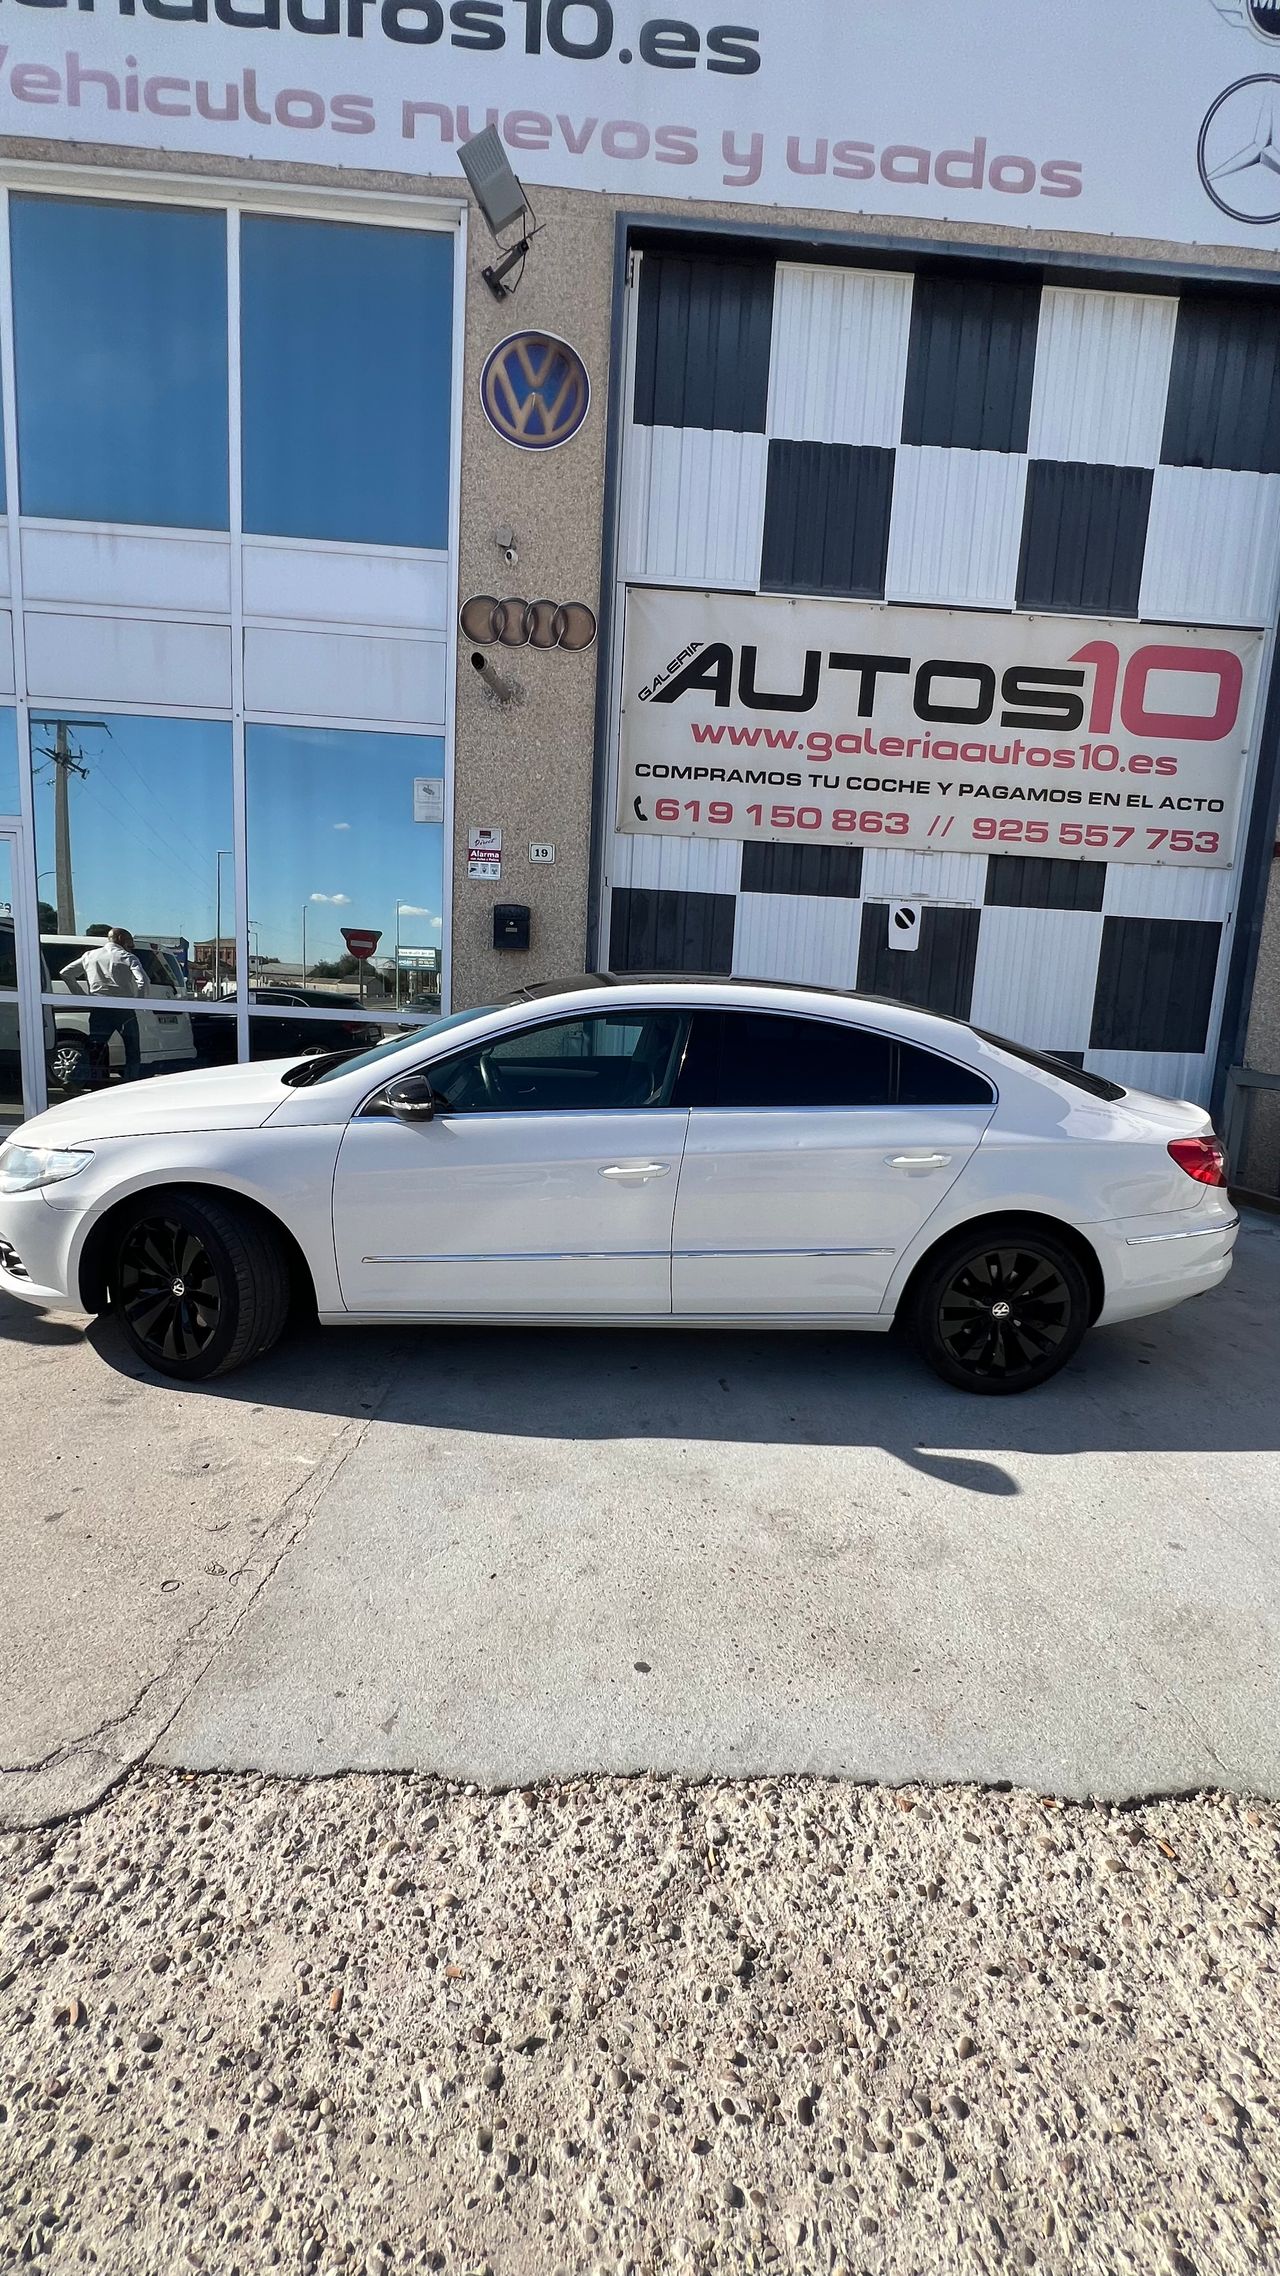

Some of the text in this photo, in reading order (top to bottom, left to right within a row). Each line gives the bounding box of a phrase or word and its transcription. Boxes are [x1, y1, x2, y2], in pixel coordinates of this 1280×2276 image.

[0, 46, 1083, 199] ehiculos nuevos y usados
[637, 642, 705, 702] GALERIA
[650, 640, 1243, 741] AUTOS10
[691, 723, 1178, 776] www.galeriaautos10.es
[635, 763, 1225, 813] COMPRAMOS TU COCHE Y PAGAMOS EN EL ACTO
[534, 848, 549, 858] 19
[655, 797, 734, 825] 619
[746, 803, 822, 830] 150
[831, 808, 910, 835] 863
[972, 817, 1049, 843] 925
[1058, 822, 1136, 848] 557
[1145, 828, 1220, 854] 753
[470, 850, 500, 859] Alarma
